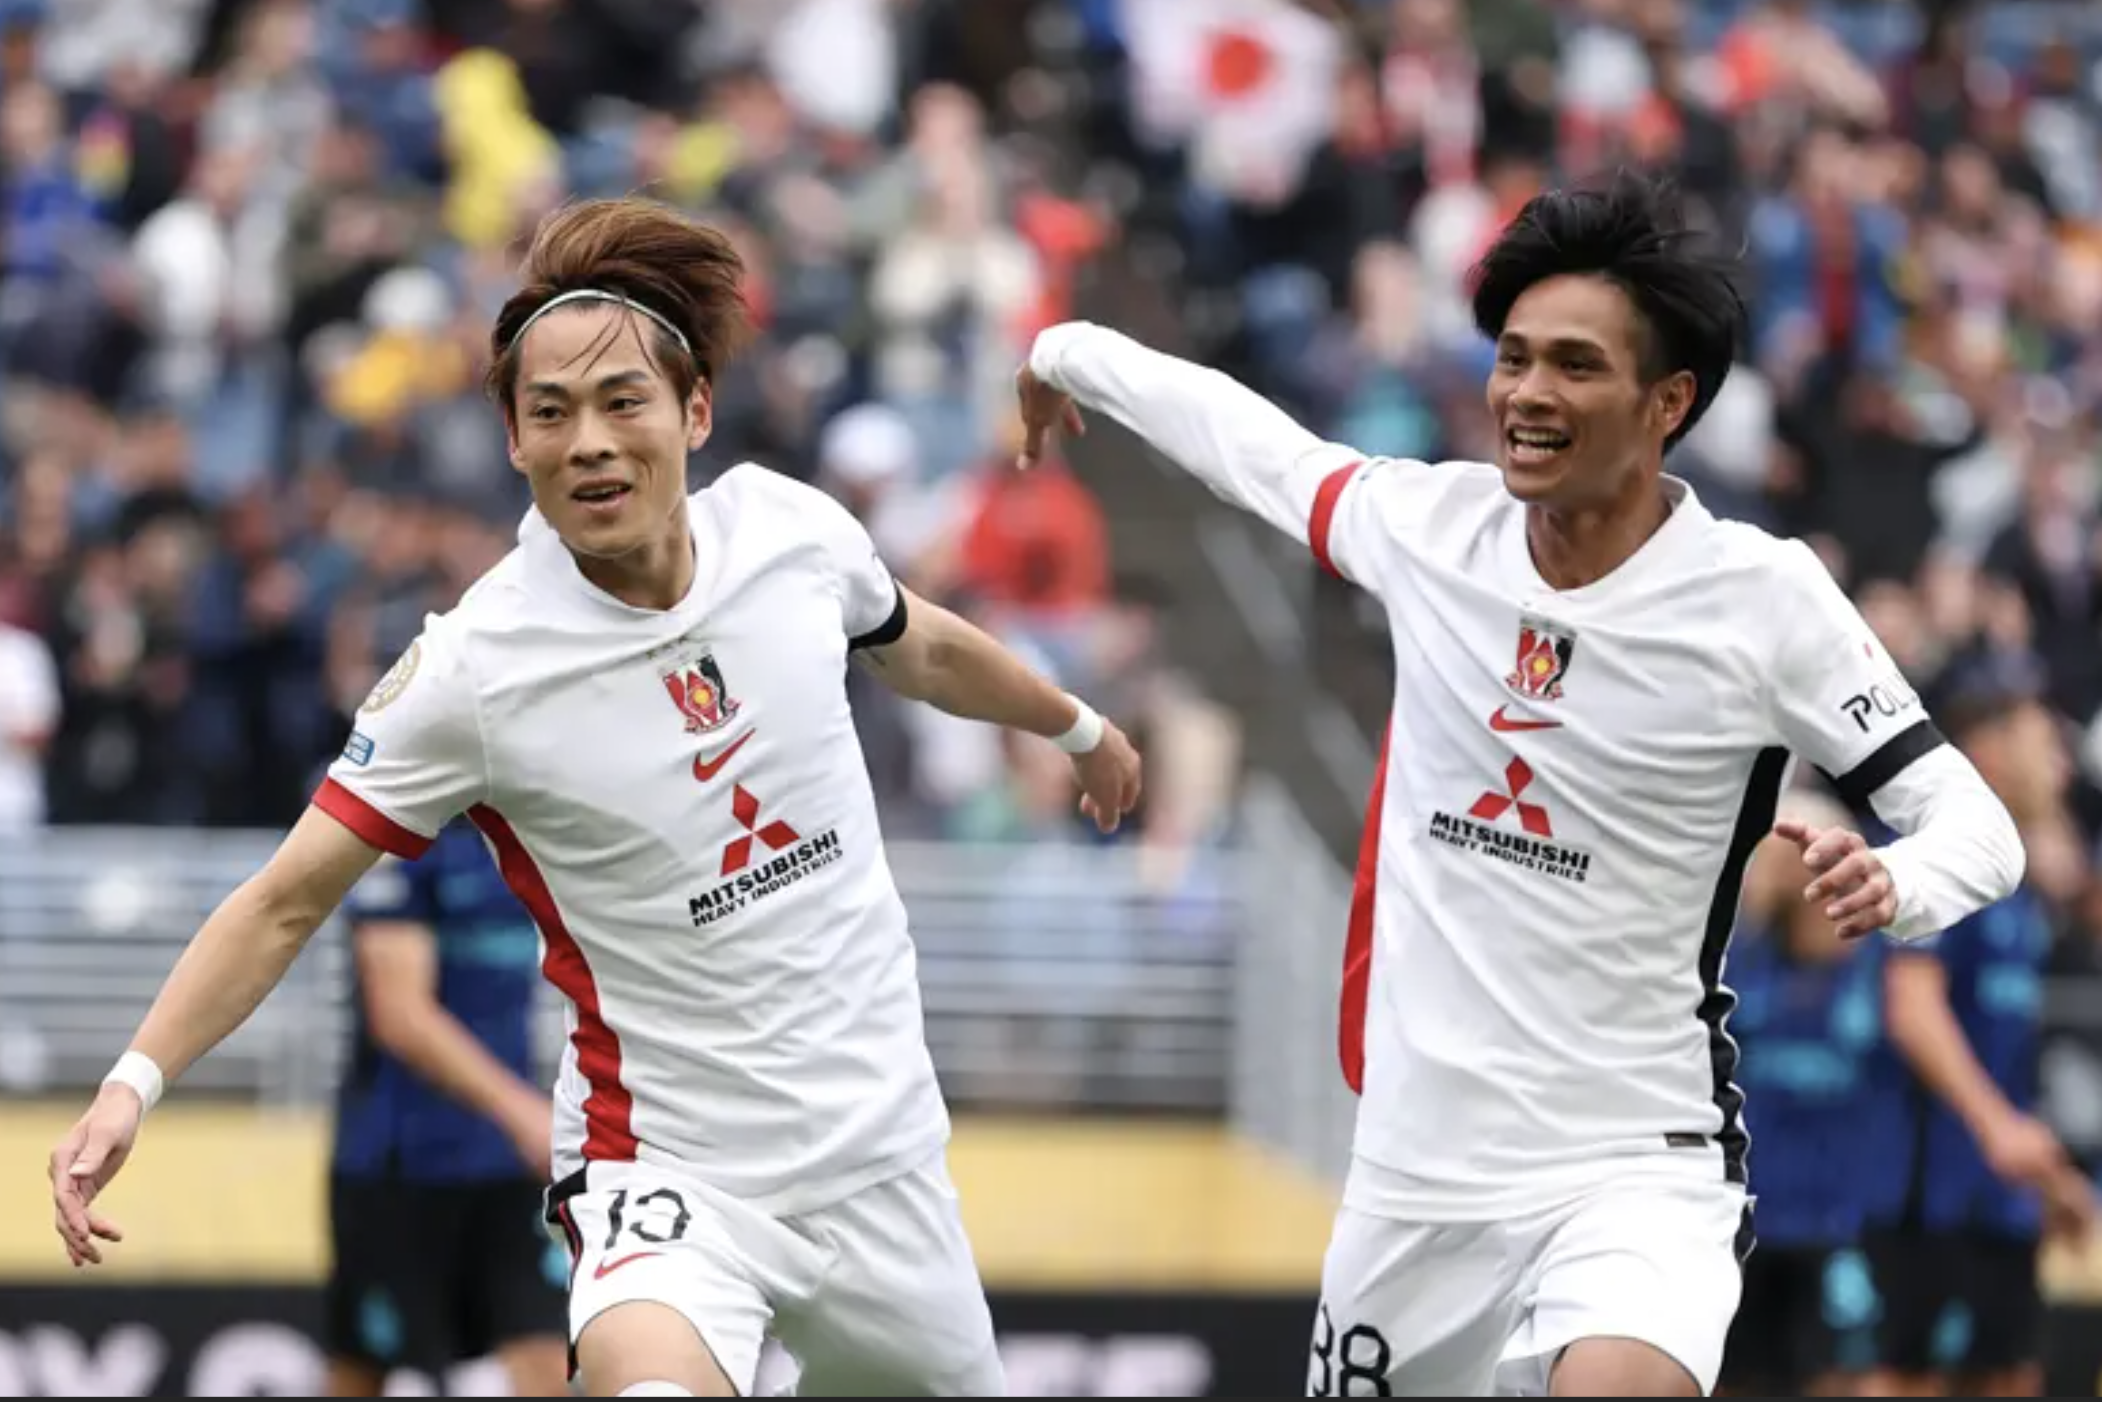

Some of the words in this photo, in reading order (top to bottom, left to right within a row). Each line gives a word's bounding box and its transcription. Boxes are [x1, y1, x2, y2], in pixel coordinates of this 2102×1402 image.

[1840, 681, 1918, 734] POL
[1429, 828, 1478, 851] HEAVY
[1481, 844, 1587, 883] INDUSTRIES
[1432, 811, 1590, 870] MITSUBISHI
[689, 829, 839, 916] MITSUBISHI
[692, 896, 746, 927] HEAVY
[751, 849, 844, 901] INDUSTRIES
